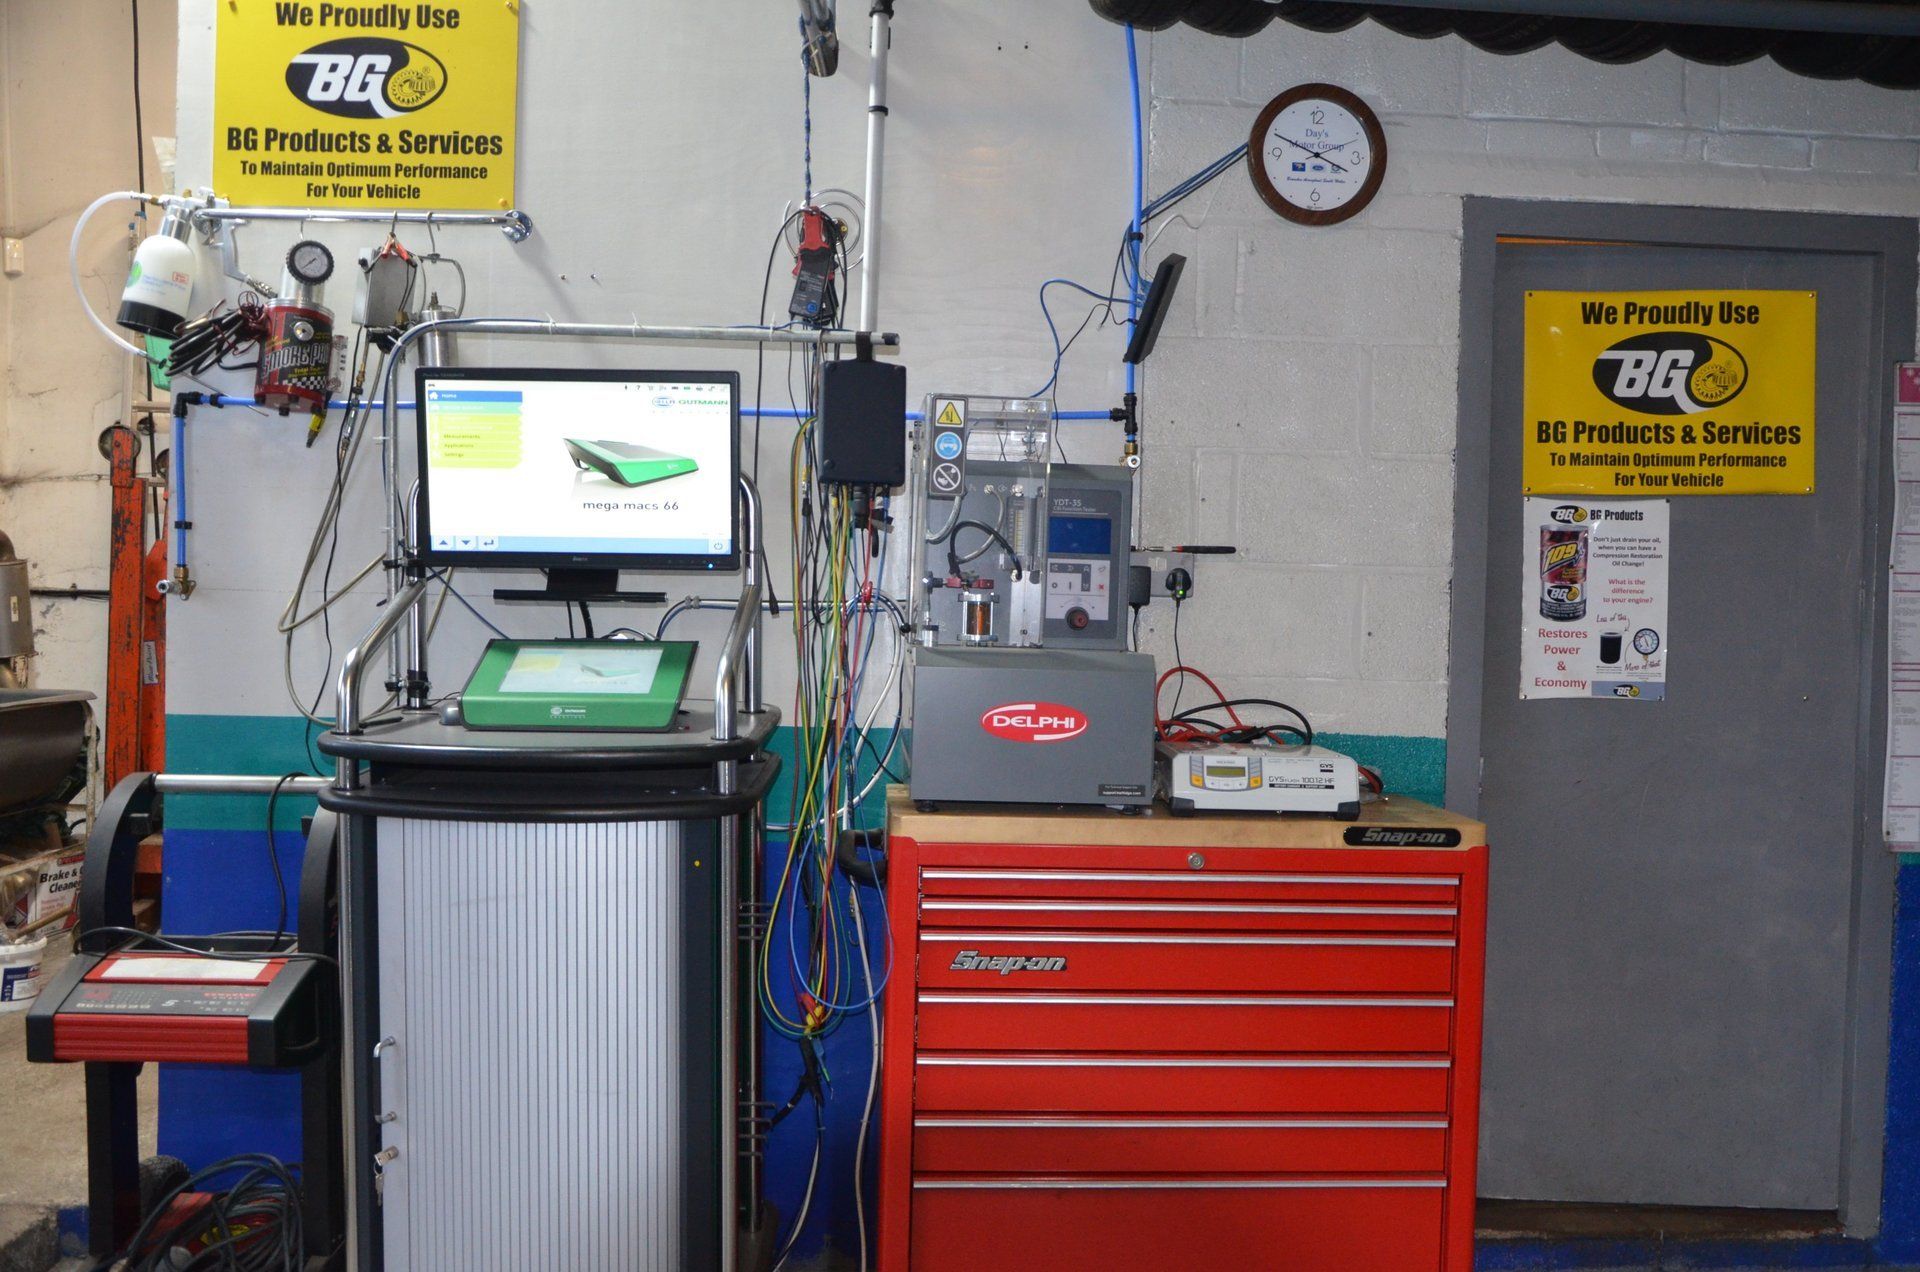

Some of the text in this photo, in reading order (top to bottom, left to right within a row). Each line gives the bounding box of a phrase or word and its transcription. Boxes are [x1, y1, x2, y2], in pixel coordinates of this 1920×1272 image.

[276, 2, 460, 31] We Proudly Use
[298, 53, 393, 104] BG
[1310, 110, 1325, 125] 12
[227, 127, 504, 156] BG Products & Services
[1305, 129, 1329, 140] Day's
[1318, 140, 1345, 152] Group
[1271, 147, 1283, 161] 9
[1350, 151, 1361, 165] 3
[240, 160, 488, 179] To Maintain Optimum Performance
[306, 183, 421, 199] For Your Vehicle
[1310, 188, 1321, 202] 6
[1581, 301, 1760, 326] We Proudly Use
[1602, 349, 1696, 399] BG
[1536, 420, 1801, 446] BG Products & Services
[1550, 452, 1787, 469] To Maintain Optimum Performance
[1614, 473, 1724, 488] For Your Vehicle
[582, 500, 680, 512] mega macs 66
[1554, 508, 1575, 520] BG
[1590, 509, 1644, 521] BG Products
[1550, 587, 1569, 600] BG
[1538, 628, 1588, 639] Restores
[1544, 644, 1581, 655] Power
[1556, 660, 1566, 671] &
[1534, 677, 1587, 690] Economy
[993, 715, 1075, 729] DELPHI
[1361, 827, 1447, 846] Snap-on
[40, 869, 71, 884] Brake
[71, 868, 78, 877] &
[949, 950, 1066, 976] Snap-on
